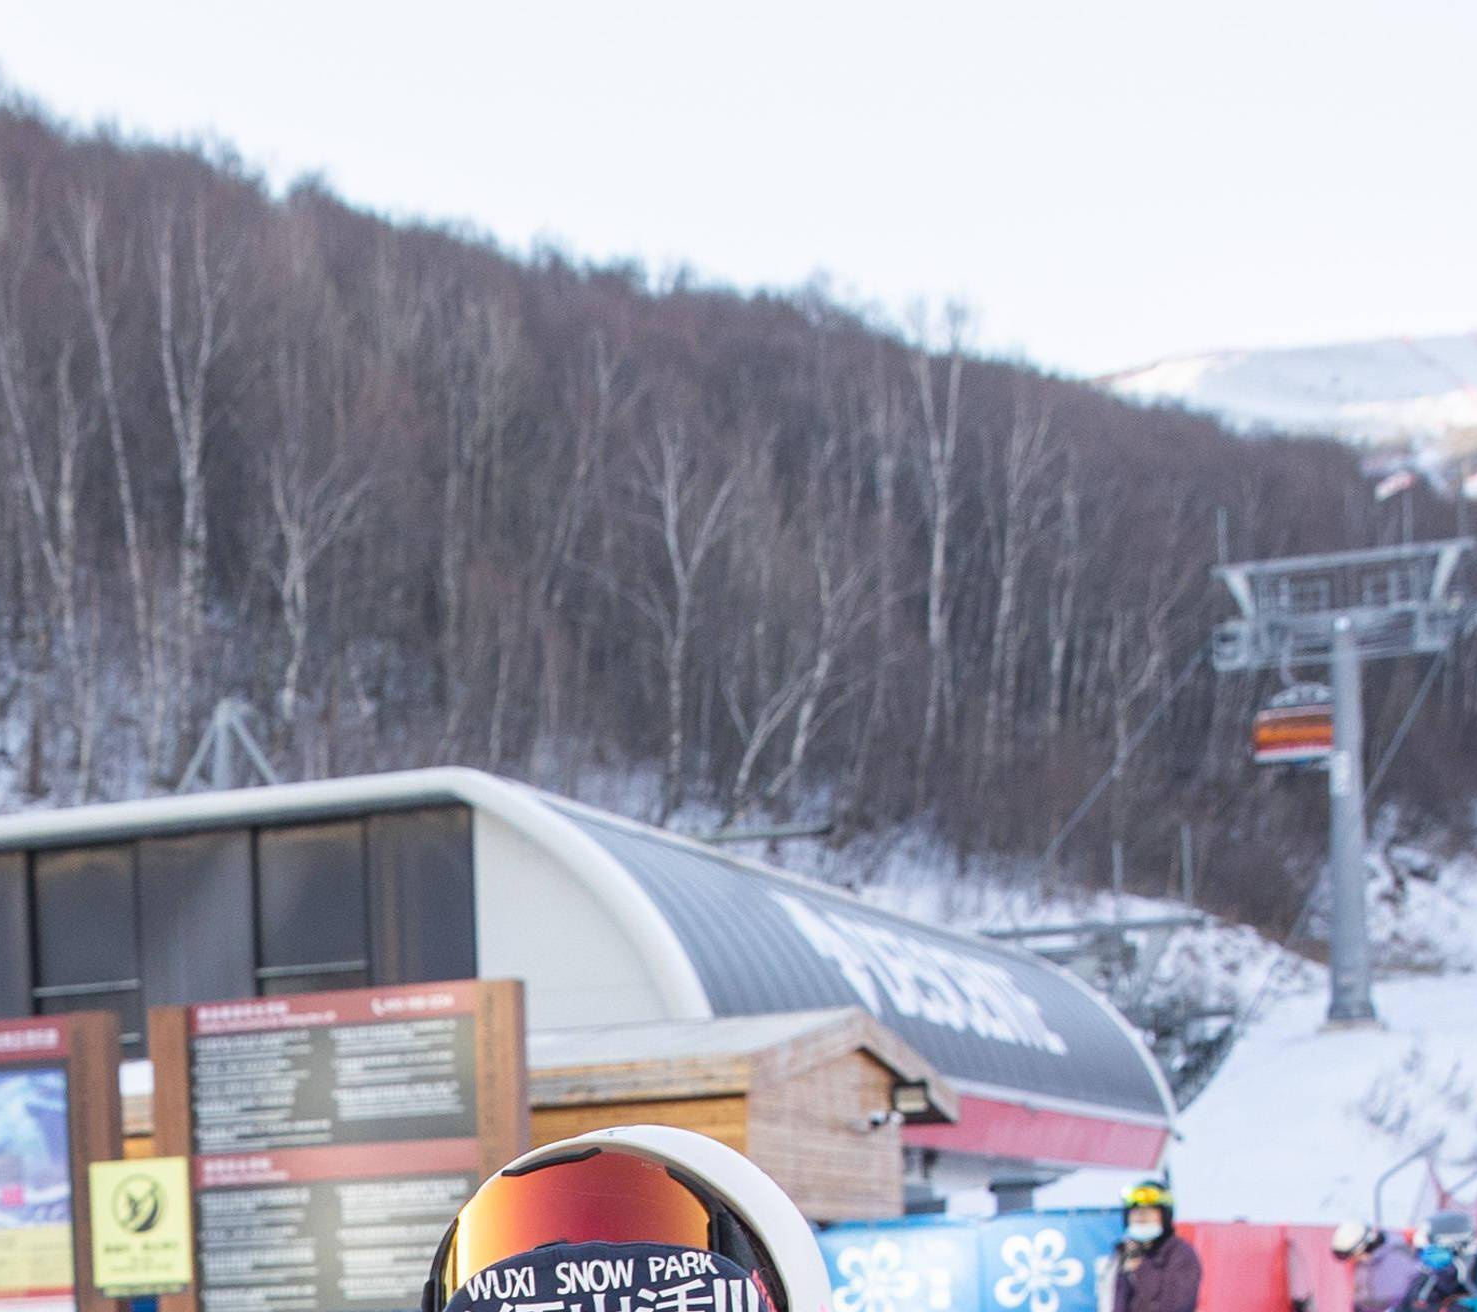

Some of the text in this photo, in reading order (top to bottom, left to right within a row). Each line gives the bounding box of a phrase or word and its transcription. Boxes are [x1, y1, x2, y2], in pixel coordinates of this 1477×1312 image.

[467, 1251, 719, 1301] WUXI SNOW PARK
